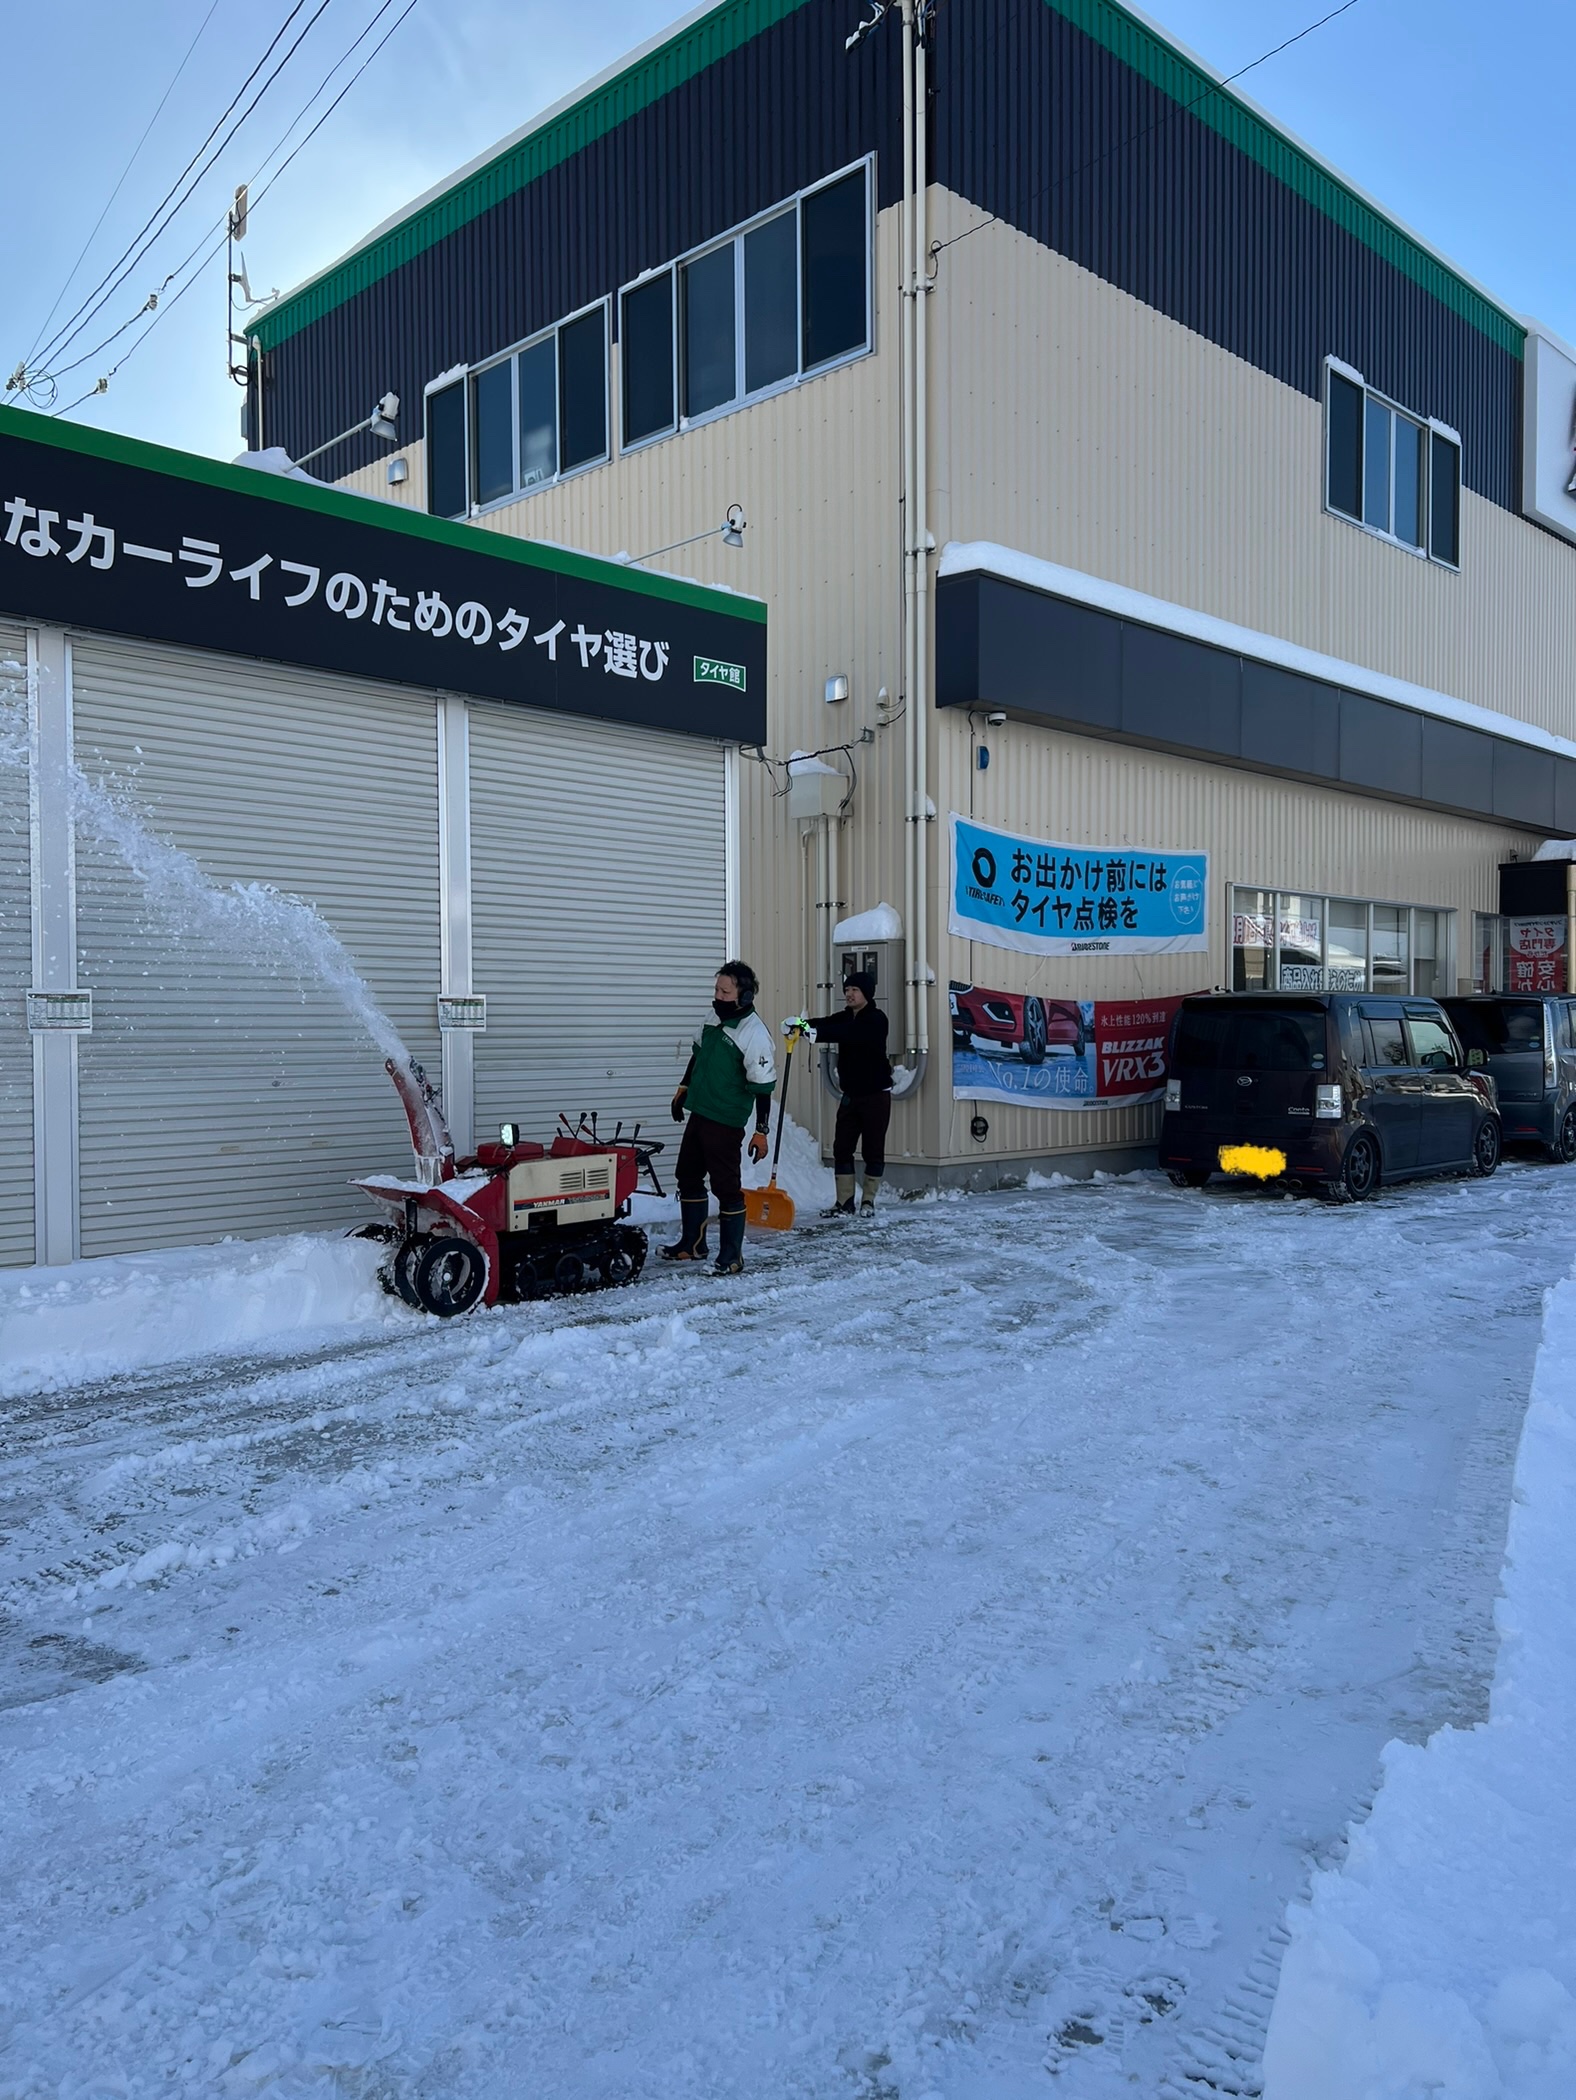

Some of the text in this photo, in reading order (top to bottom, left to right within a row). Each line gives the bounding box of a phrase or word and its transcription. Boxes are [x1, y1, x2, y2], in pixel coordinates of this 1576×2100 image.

[4, 497, 669, 681] なカーライフのためのタイヤ選び
[700, 661, 740, 684] タイヤ館
[1011, 848, 1167, 893] お出かけ前には
[1011, 888, 1138, 931] タイヤ点検を
[1101, 1036, 1165, 1055] BLIZZAK
[1102, 1051, 1166, 1087] VRX3
